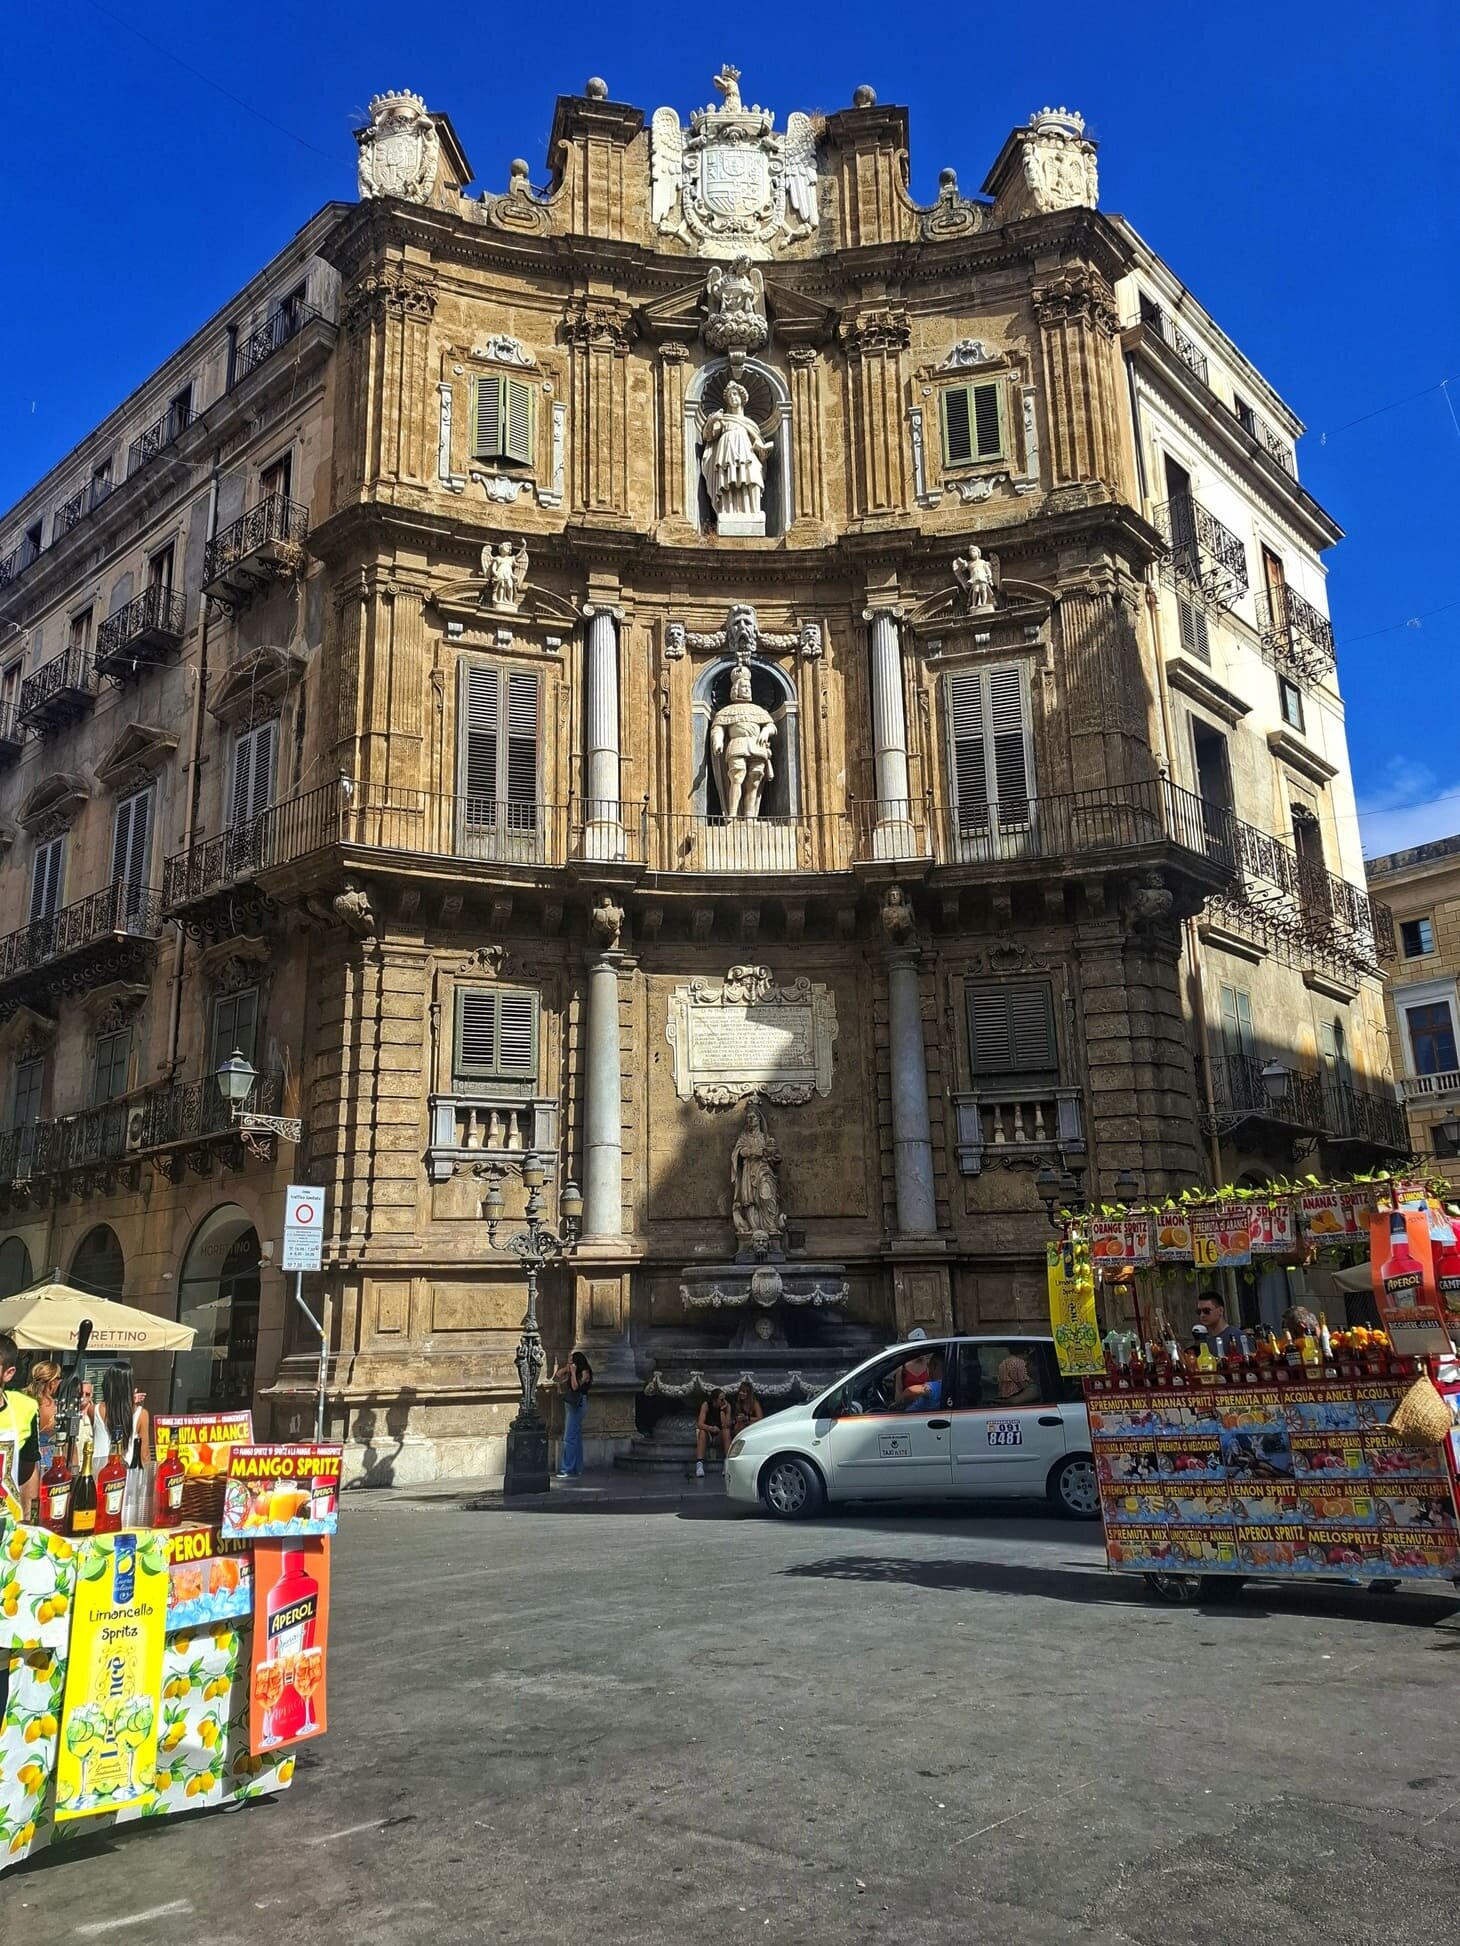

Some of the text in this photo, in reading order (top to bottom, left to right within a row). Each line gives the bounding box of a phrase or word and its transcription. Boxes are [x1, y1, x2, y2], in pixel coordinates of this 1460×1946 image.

[1302, 1193, 1369, 1211] ANANAS SPRITZ
[1093, 1222, 1148, 1234] ORANGE SPRITZ
[1156, 1214, 1185, 1228] LEMON
[1387, 1274, 1421, 1293] APEROL
[69, 1330, 147, 1342] MRETTINO
[1215, 1393, 1280, 1406] SPREMUTA MIX
[1284, 1391, 1315, 1403] ACQUA
[1326, 1390, 1353, 1402] ANICE
[1356, 1387, 1390, 1401] ACQUA
[1090, 1398, 1149, 1411] SPREMUTA MIX
[1151, 1395, 1214, 1409] ANANAS SPRITZ
[198, 1426, 208, 1442] di
[209, 1423, 250, 1442] ARANCE
[999, 1423, 1020, 1431] 091
[989, 1431, 1021, 1446] 8481
[230, 1456, 340, 1477] MANGO SPRITZ
[1136, 1484, 1161, 1496] ANANAS
[1164, 1485, 1195, 1497] SPREMUTA
[1203, 1485, 1227, 1497] LIMONE
[1229, 1484, 1297, 1497] LEMON SPRITZ
[1300, 1485, 1336, 1497] LIMONCELLO
[1345, 1485, 1371, 1497] ARANCE
[1108, 1529, 1169, 1541] SPREMUTA MIX
[1238, 1526, 1274, 1542] APEROL
[1275, 1525, 1306, 1541] SPRITZ
[1308, 1529, 1380, 1545] MELOSPRITZ
[1382, 1531, 1435, 1546] SPREMUTA
[89, 1603, 154, 1622] Limoncello
[271, 1601, 314, 1634] APEROL
[101, 1625, 139, 1645] Spritz
